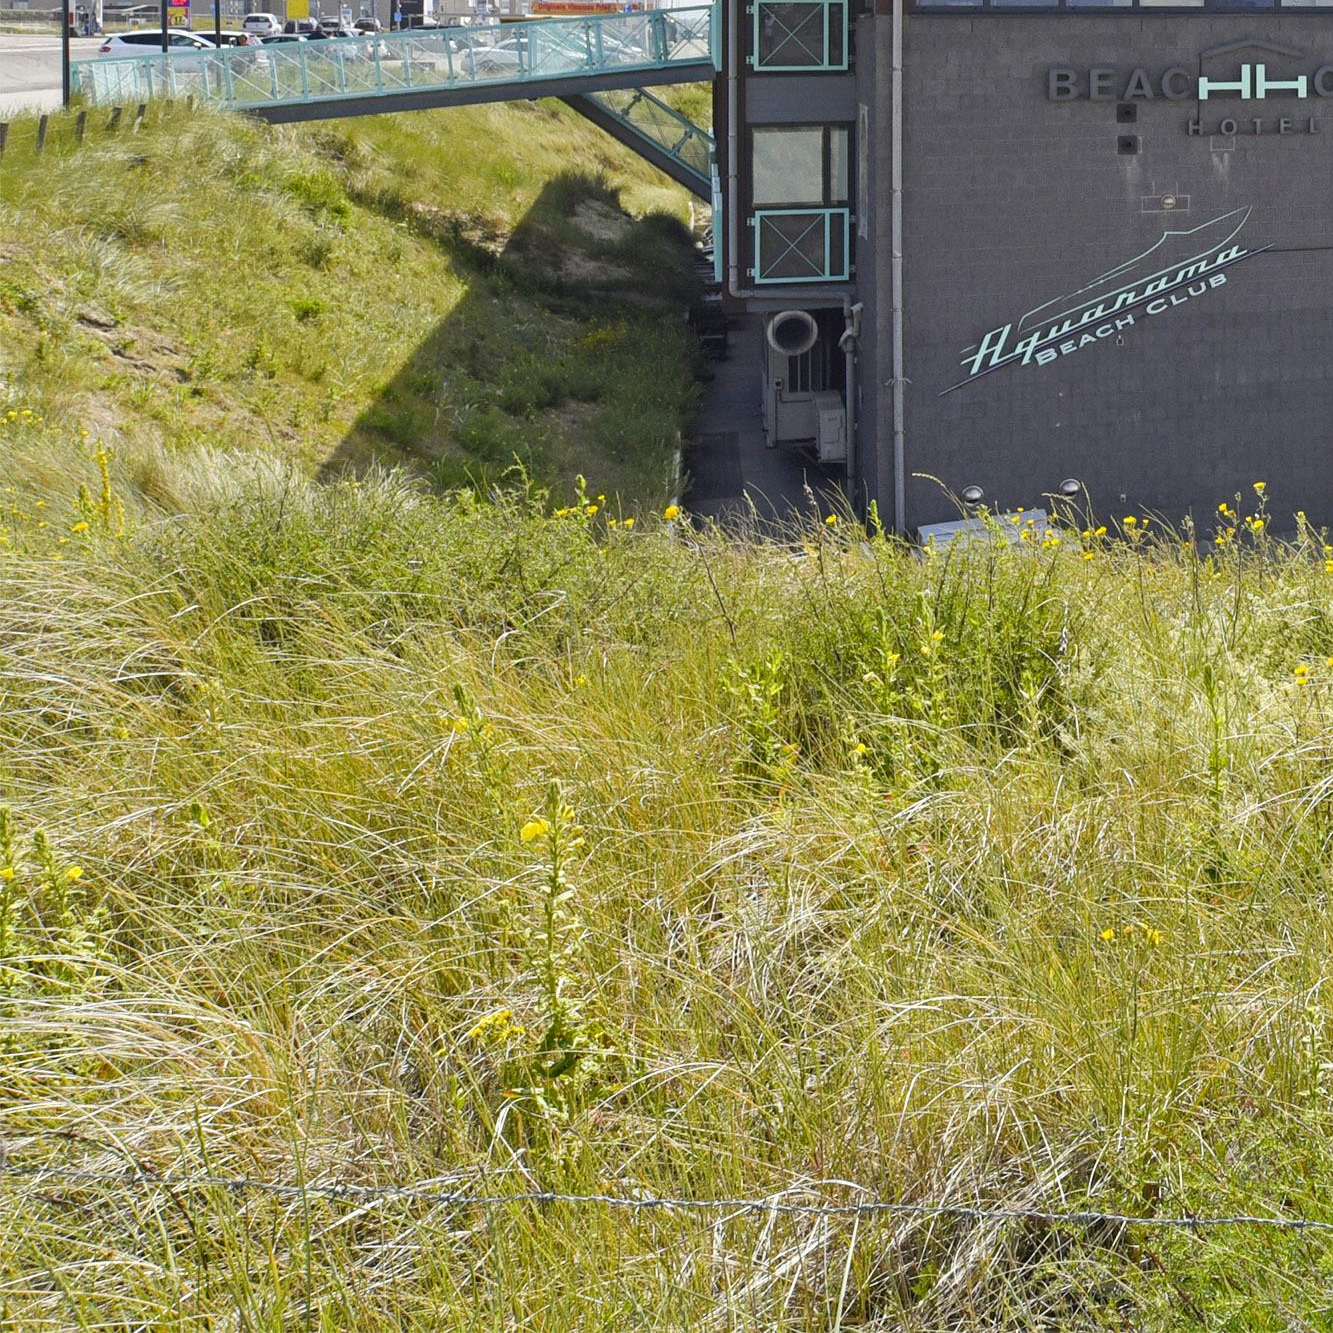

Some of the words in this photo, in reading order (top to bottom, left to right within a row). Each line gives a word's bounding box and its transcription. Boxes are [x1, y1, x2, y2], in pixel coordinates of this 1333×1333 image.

[1186, 117, 1321, 137] HOTEL
[960, 244, 1248, 375] Aquarama
[1034, 313, 1136, 366] BEACH
[1145, 272, 1228, 315] CLUB
